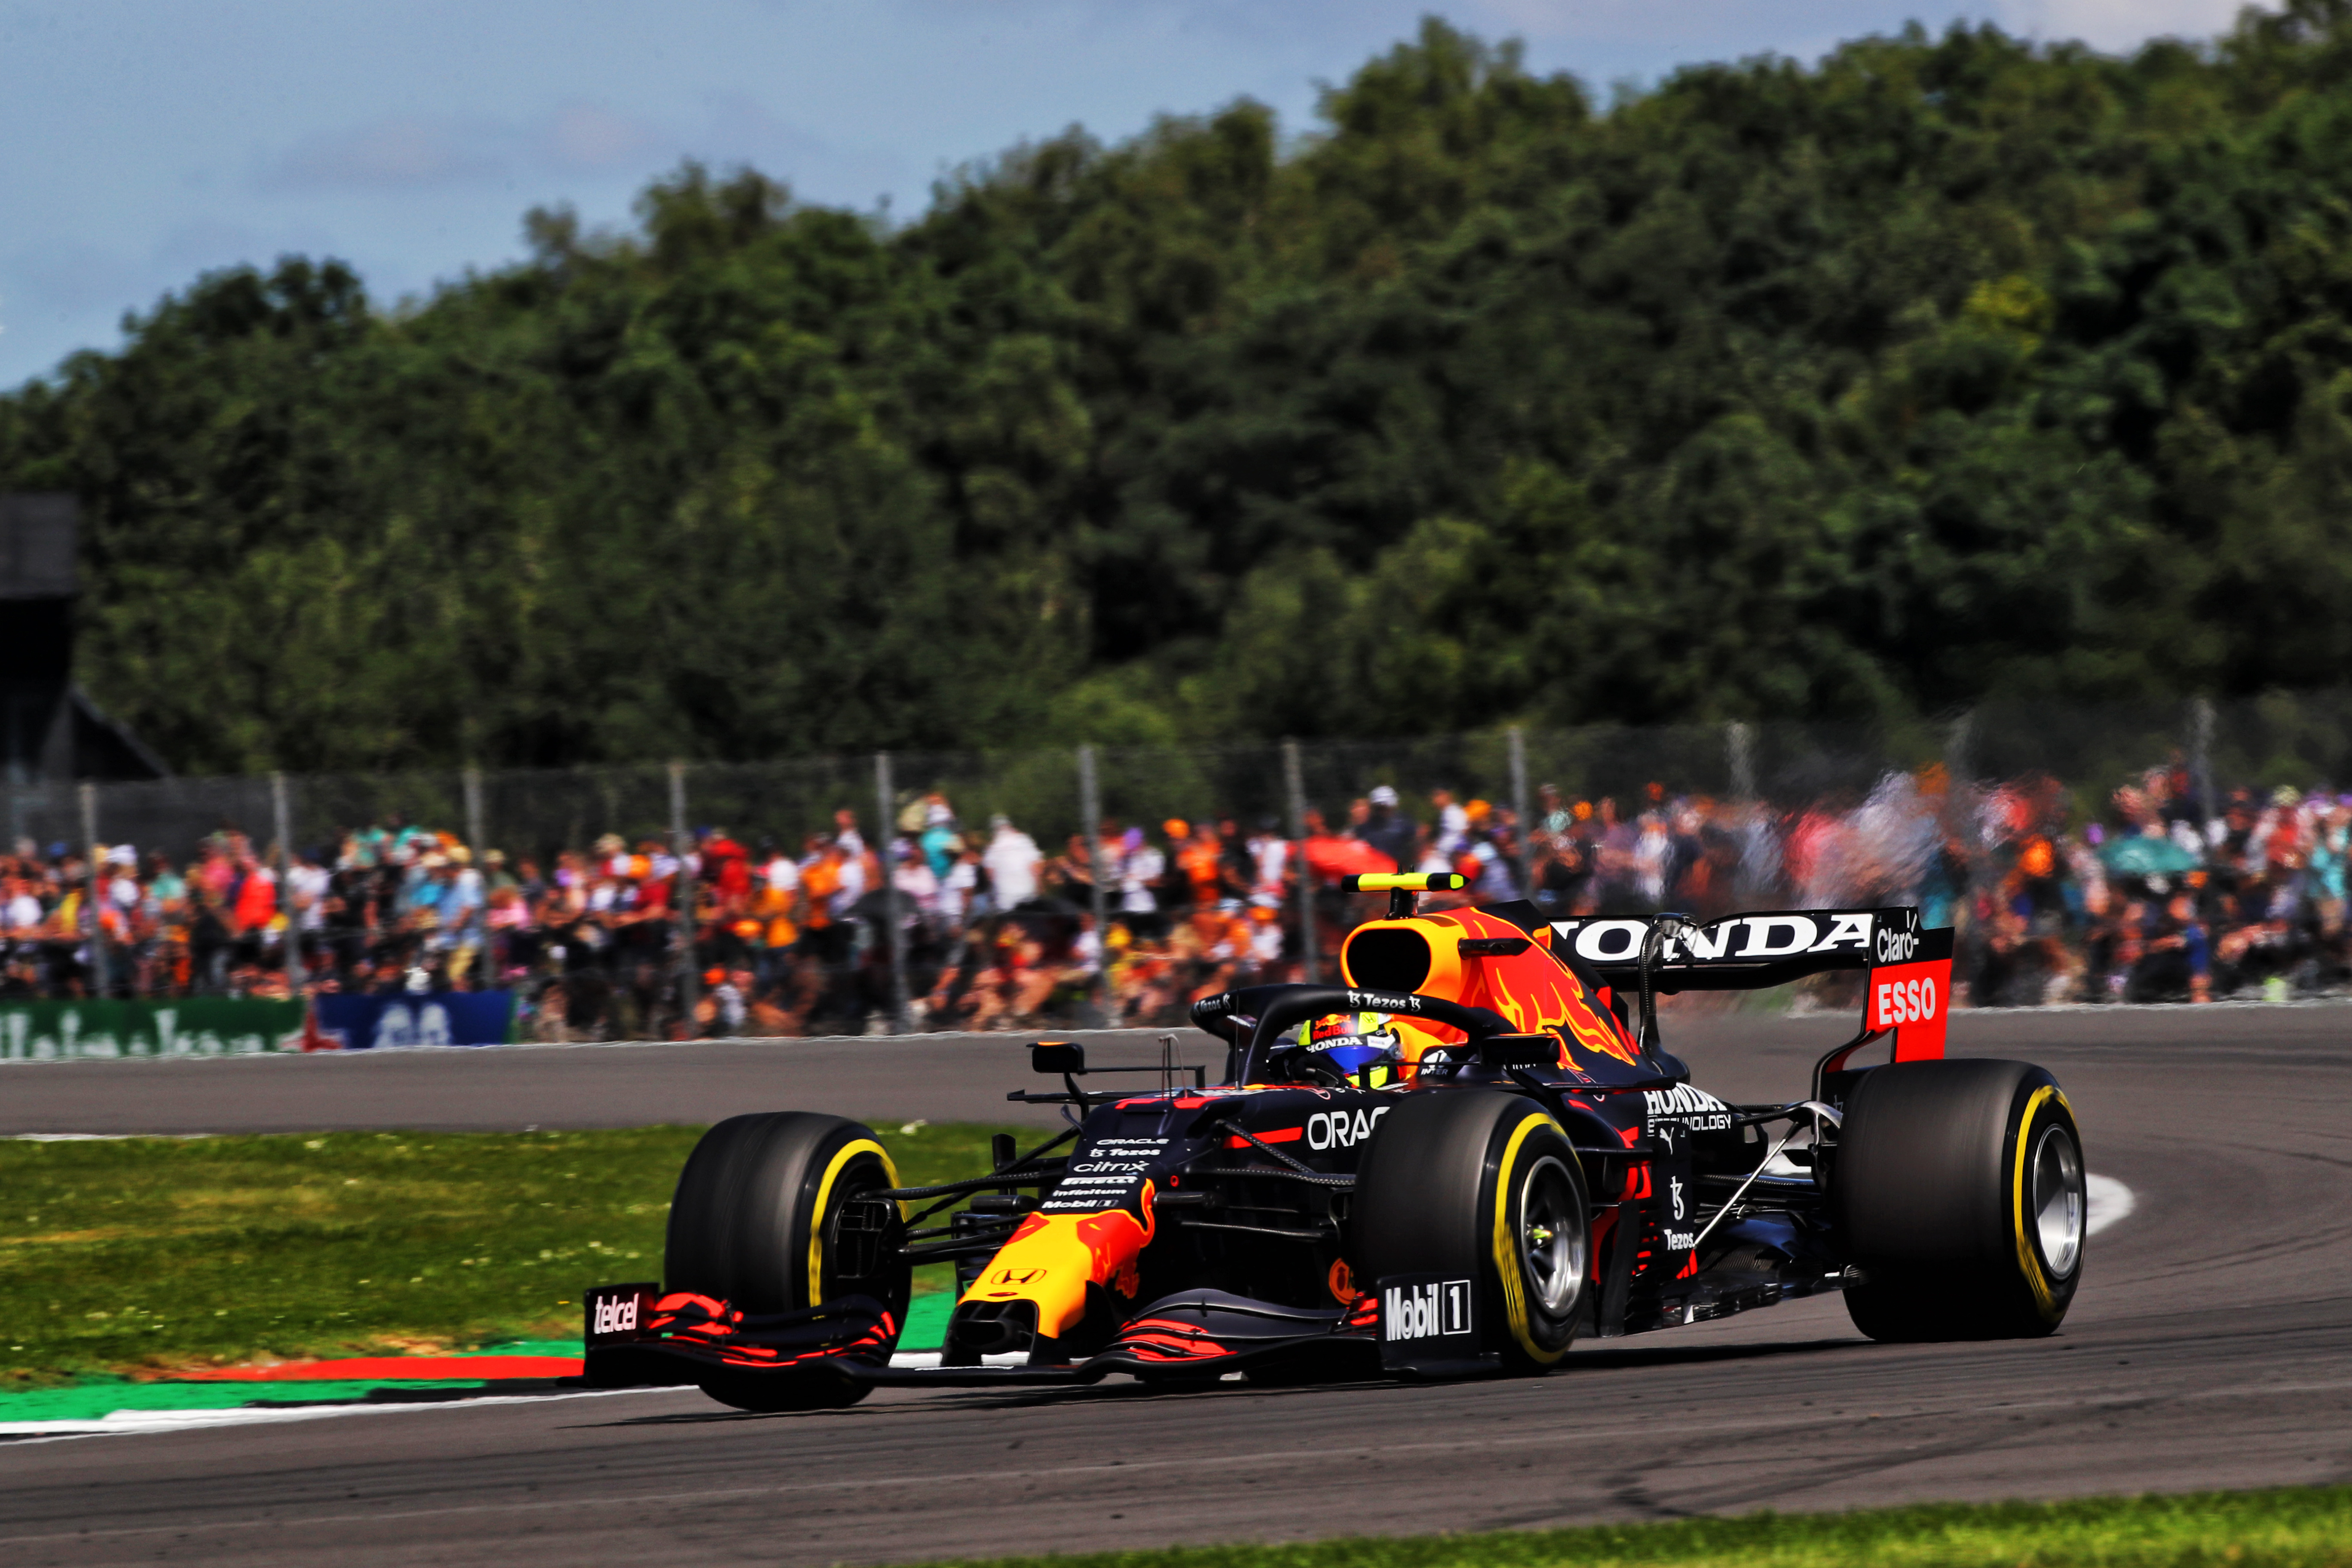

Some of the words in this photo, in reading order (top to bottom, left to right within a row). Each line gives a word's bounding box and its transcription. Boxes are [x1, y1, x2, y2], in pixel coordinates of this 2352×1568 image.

[1550, 913, 1873, 961] ONDA
[1877, 927, 1914, 963] Claro
[1363, 993, 1406, 1009] Tezos
[1878, 977, 1936, 1025] ESSO
[1306, 1036, 1363, 1053] HONDA
[1313, 1026, 1332, 1040] Red
[1333, 1023, 1354, 1035] Bull
[1643, 1082, 1727, 1115] HONDA
[1109, 1148, 1161, 1156] Tezos
[1041, 1200, 1098, 1209] Mobil
[1664, 1229, 1694, 1250] Tezos
[594, 1292, 639, 1334] telcel
[1385, 1283, 1439, 1341] Mobil
